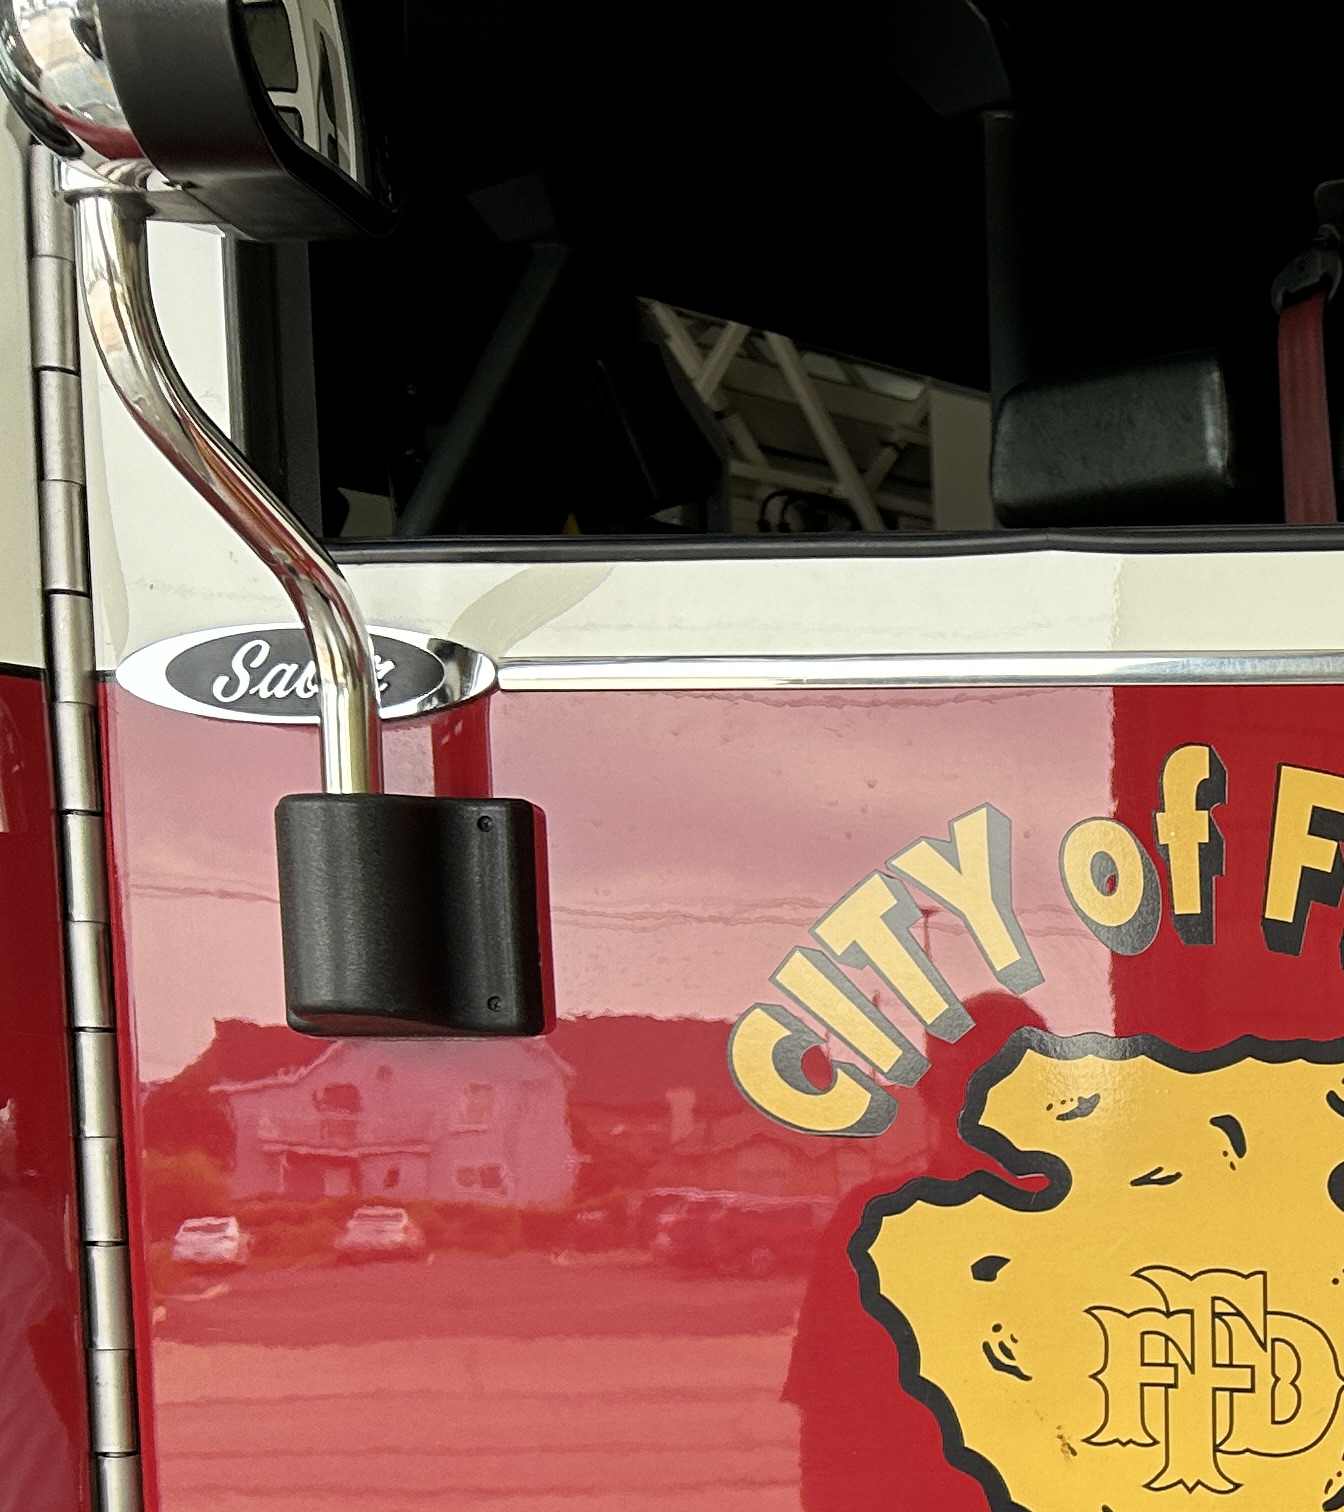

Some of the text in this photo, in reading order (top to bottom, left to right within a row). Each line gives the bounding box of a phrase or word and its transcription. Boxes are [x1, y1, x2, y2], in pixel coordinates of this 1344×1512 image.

[212, 639, 397, 704] Sabr
[726, 801, 1046, 1138] CITY
[1058, 742, 1228, 956] of
